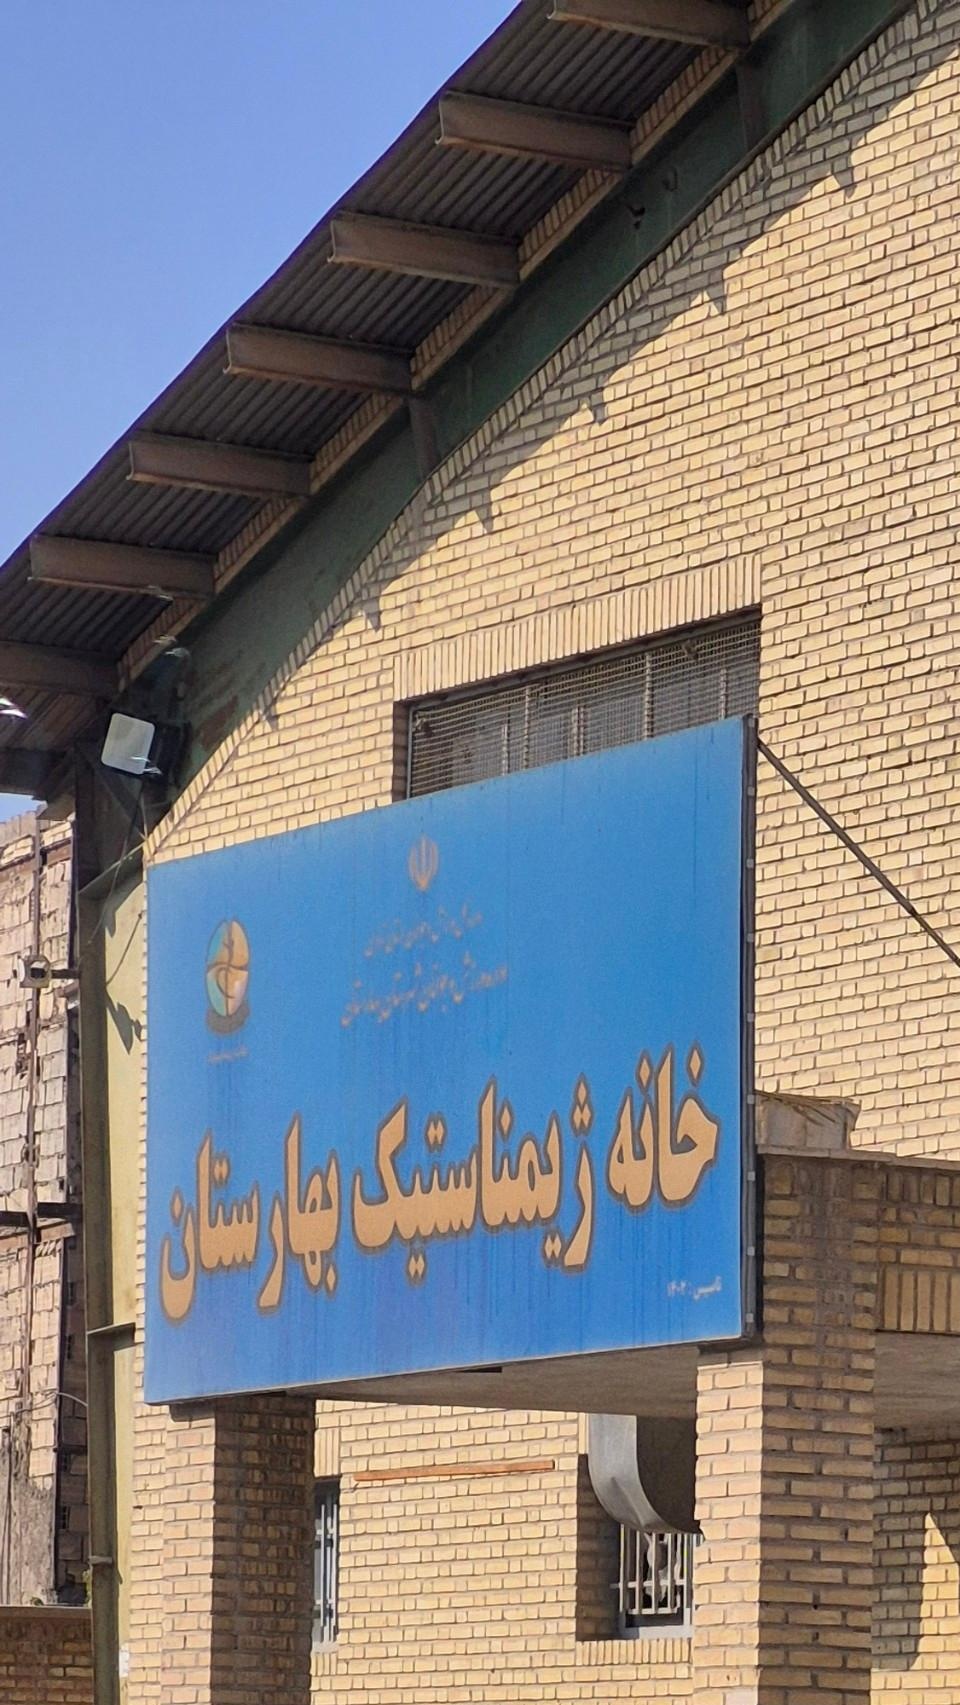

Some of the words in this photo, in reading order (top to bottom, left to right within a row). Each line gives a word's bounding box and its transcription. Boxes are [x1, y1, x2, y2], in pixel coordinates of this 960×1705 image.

[159, 1111, 341, 1327] بهارستان
[351, 1075, 596, 1283] ژیمناستیک
[604, 1043, 719, 1209] خانه
